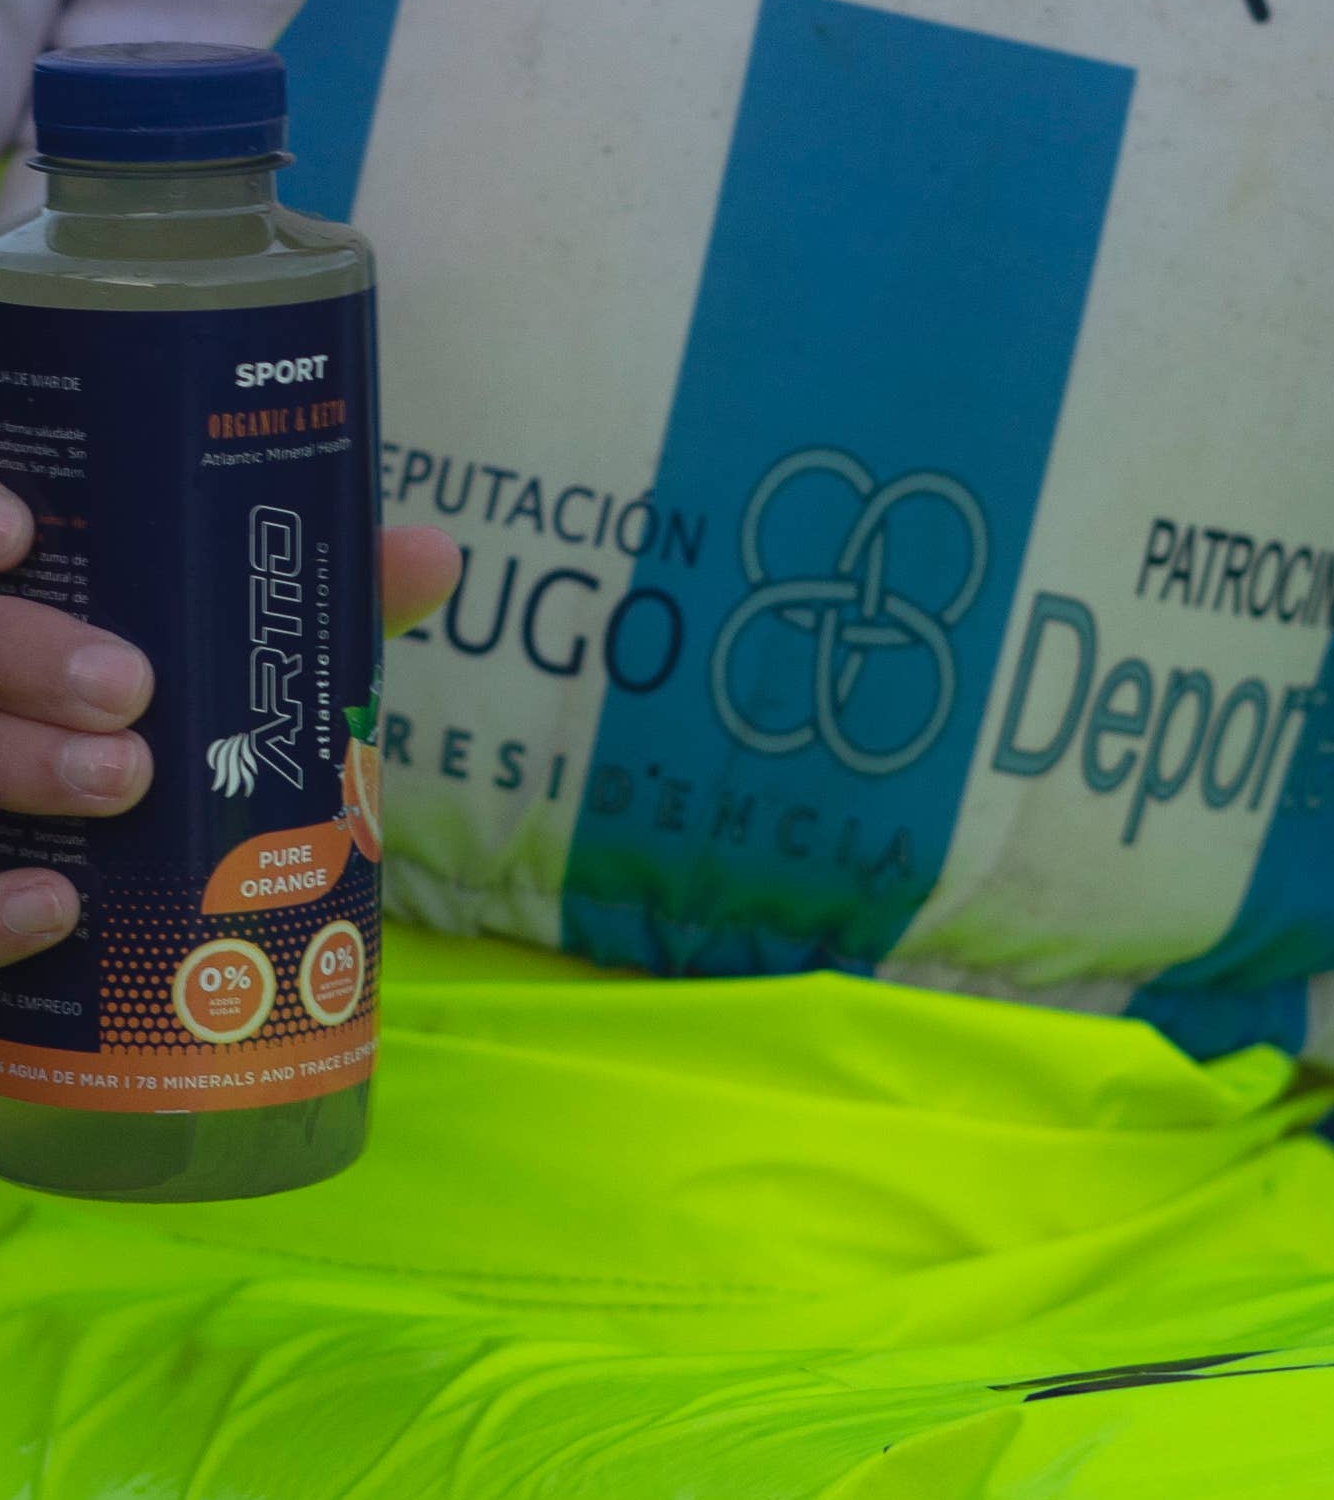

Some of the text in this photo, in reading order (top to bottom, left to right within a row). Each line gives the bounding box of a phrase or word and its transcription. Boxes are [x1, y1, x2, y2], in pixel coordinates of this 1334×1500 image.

[235, 354, 329, 388] SPORT
[208, 407, 289, 440] ORGANIC
[379, 443, 707, 570] EPUTACIÓN
[400, 545, 685, 693] UGO
[383, 713, 918, 882] RESIDENCIA
[259, 844, 313, 869] PURE
[240, 868, 327, 898] ORANGE
[320, 945, 354, 976] 0%
[199, 964, 251, 992] 0%
[17, 993, 83, 1017] EMPREGO
[7, 1063, 48, 1082] AGUA
[52, 1070, 76, 1086] DE
[80, 1073, 119, 1089] MAR
[136, 1075, 158, 1090] 78
[162, 1071, 255, 1090] MINERALS
[259, 1065, 295, 1083] AND
[298, 1054, 342, 1078] TRACE
